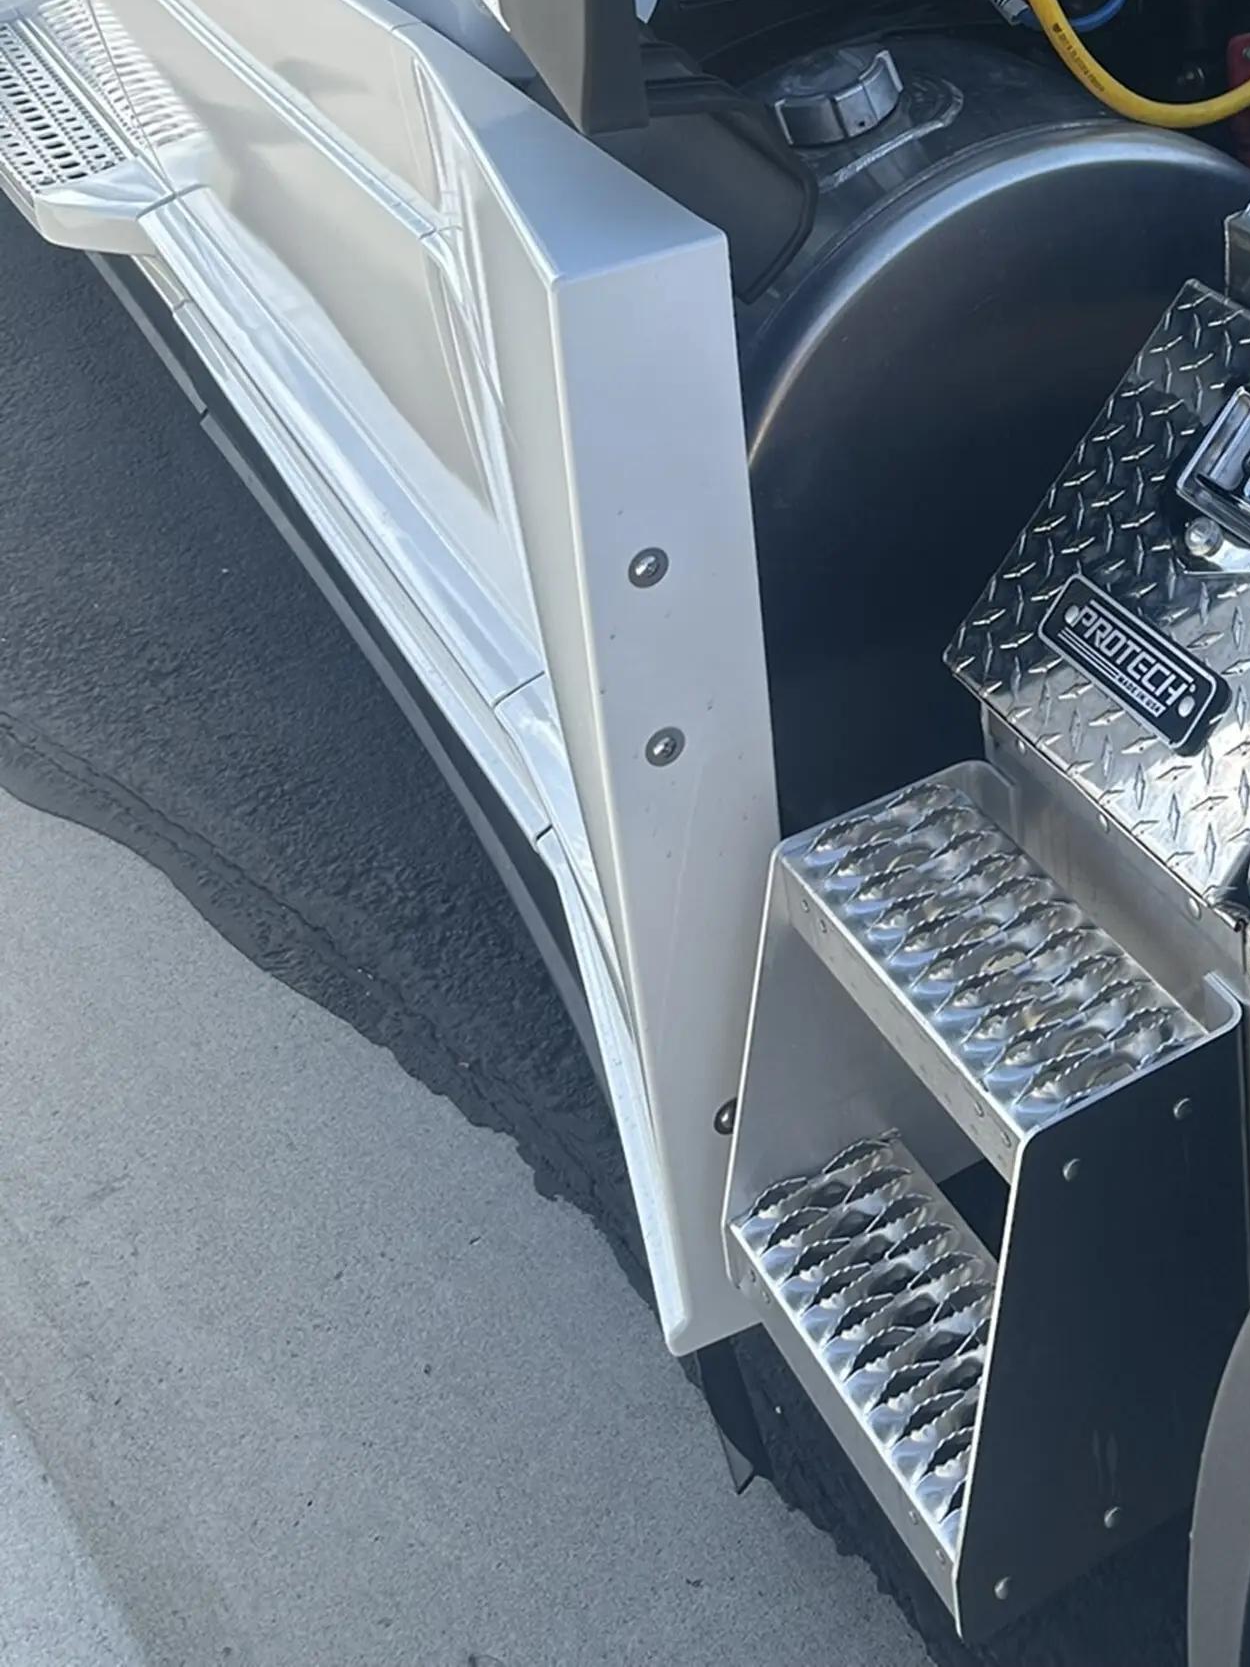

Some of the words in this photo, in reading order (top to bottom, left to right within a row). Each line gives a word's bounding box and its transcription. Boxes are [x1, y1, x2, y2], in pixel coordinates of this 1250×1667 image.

[1071, 605, 1188, 706] PROTECH
[1116, 674, 1139, 693] MADE
[1145, 698, 1162, 713] USA
